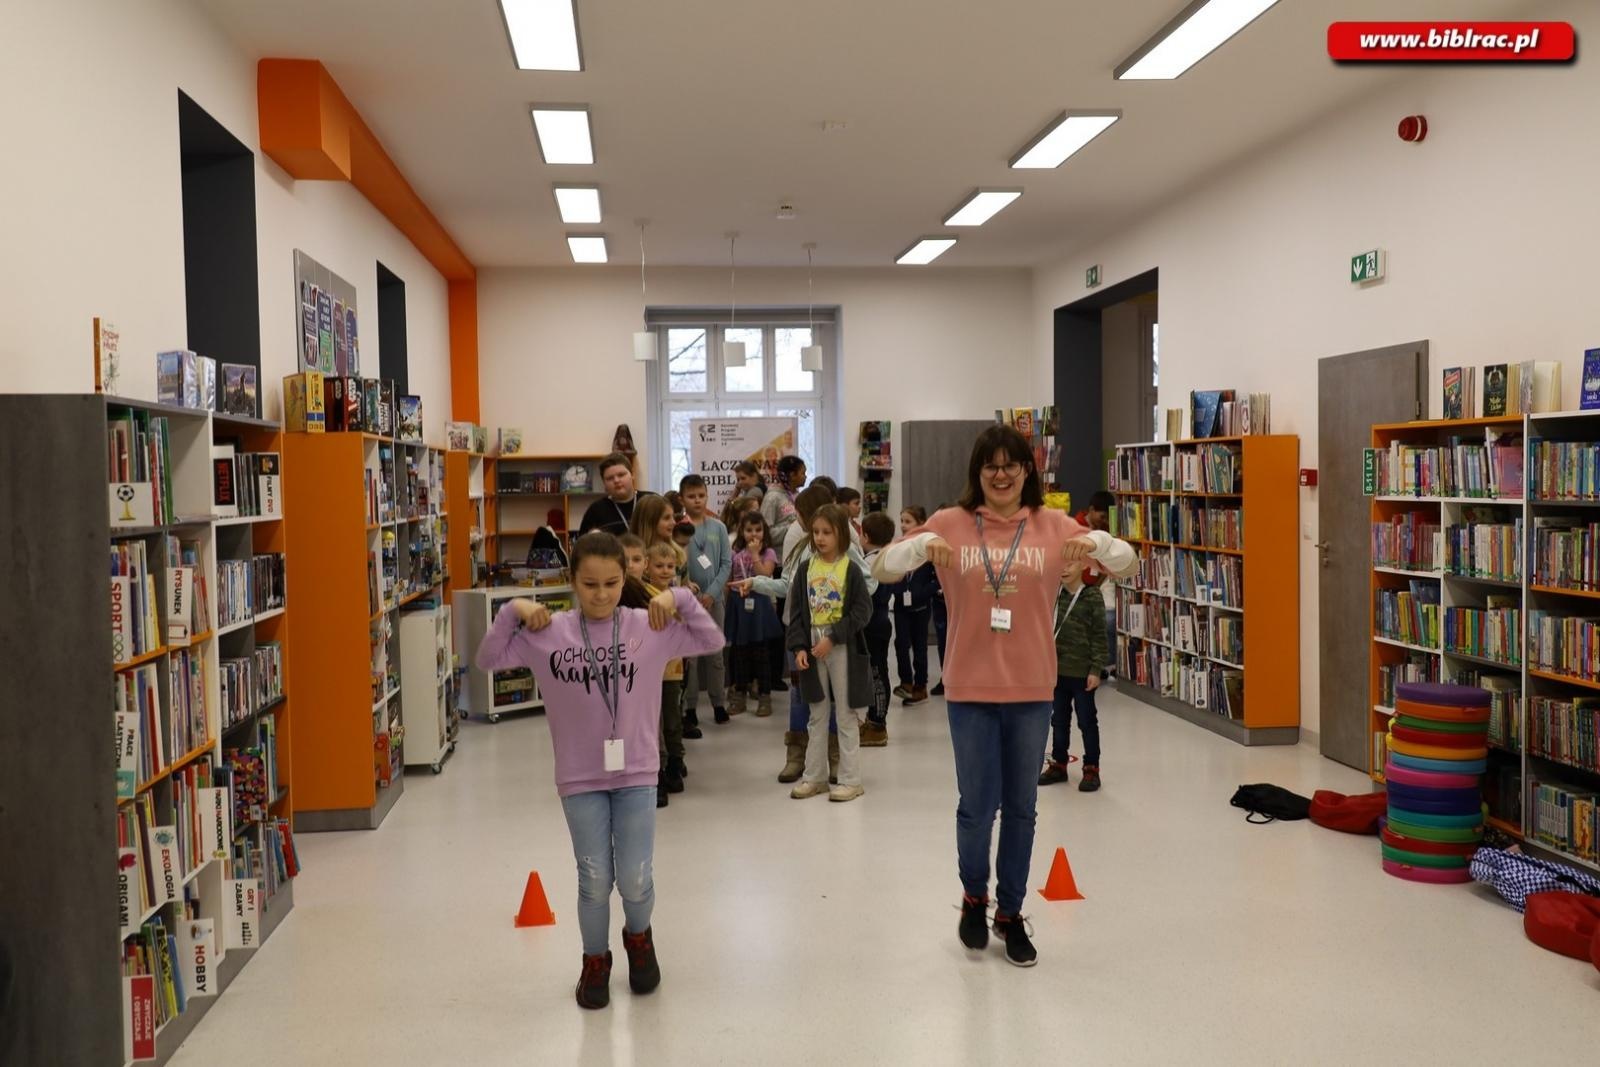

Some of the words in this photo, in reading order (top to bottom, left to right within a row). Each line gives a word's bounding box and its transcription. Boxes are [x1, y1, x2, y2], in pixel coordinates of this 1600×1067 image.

[1365, 452, 1373, 471] LAT
[216, 463, 231, 501] NETFLIX
[1366, 473, 1374, 492] 8-11
[111, 582, 122, 634] SPORT
[173, 569, 183, 616] RYSUNEK
[549, 649, 639, 695] happy
[563, 643, 627, 664] CHOOSE
[126, 729, 135, 757] PRACE
[161, 848, 175, 899] EKOLOGIA
[118, 874, 129, 927] ORIGAMI
[235, 882, 243, 917] ZABAWY
[247, 888, 255, 906] GRY
[195, 945, 206, 993] HOBBY
